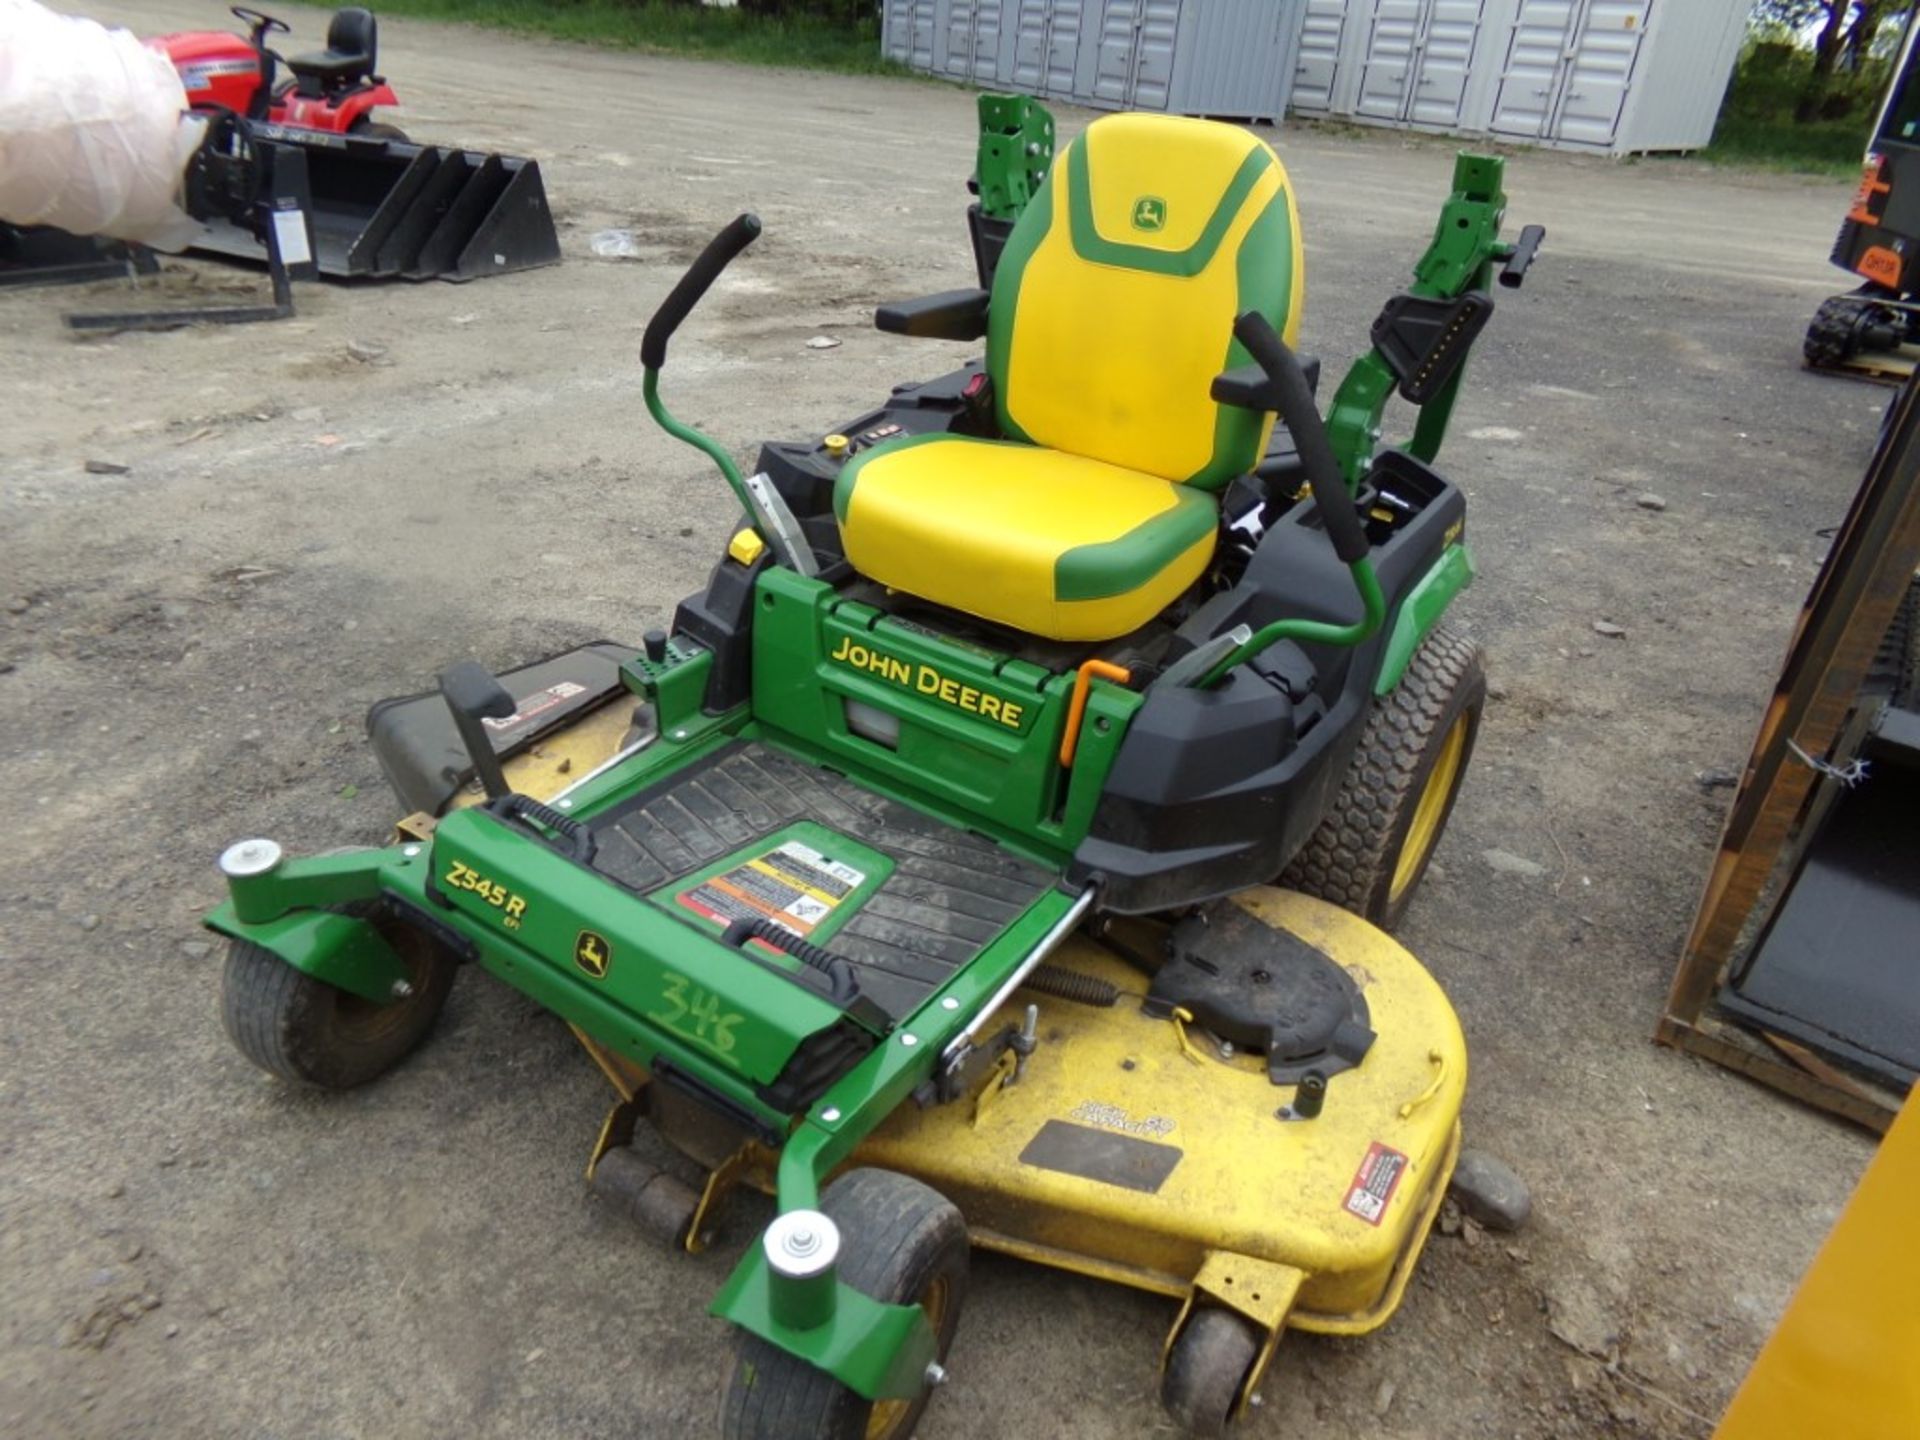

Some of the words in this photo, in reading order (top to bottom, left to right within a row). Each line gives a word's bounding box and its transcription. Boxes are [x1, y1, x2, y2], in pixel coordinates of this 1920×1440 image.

[832, 637, 911, 685] JOHN
[916, 664, 1023, 729] DEERE
[445, 860, 507, 906] Z545
[505, 895, 527, 918] R
[660, 971, 745, 1053] 346
